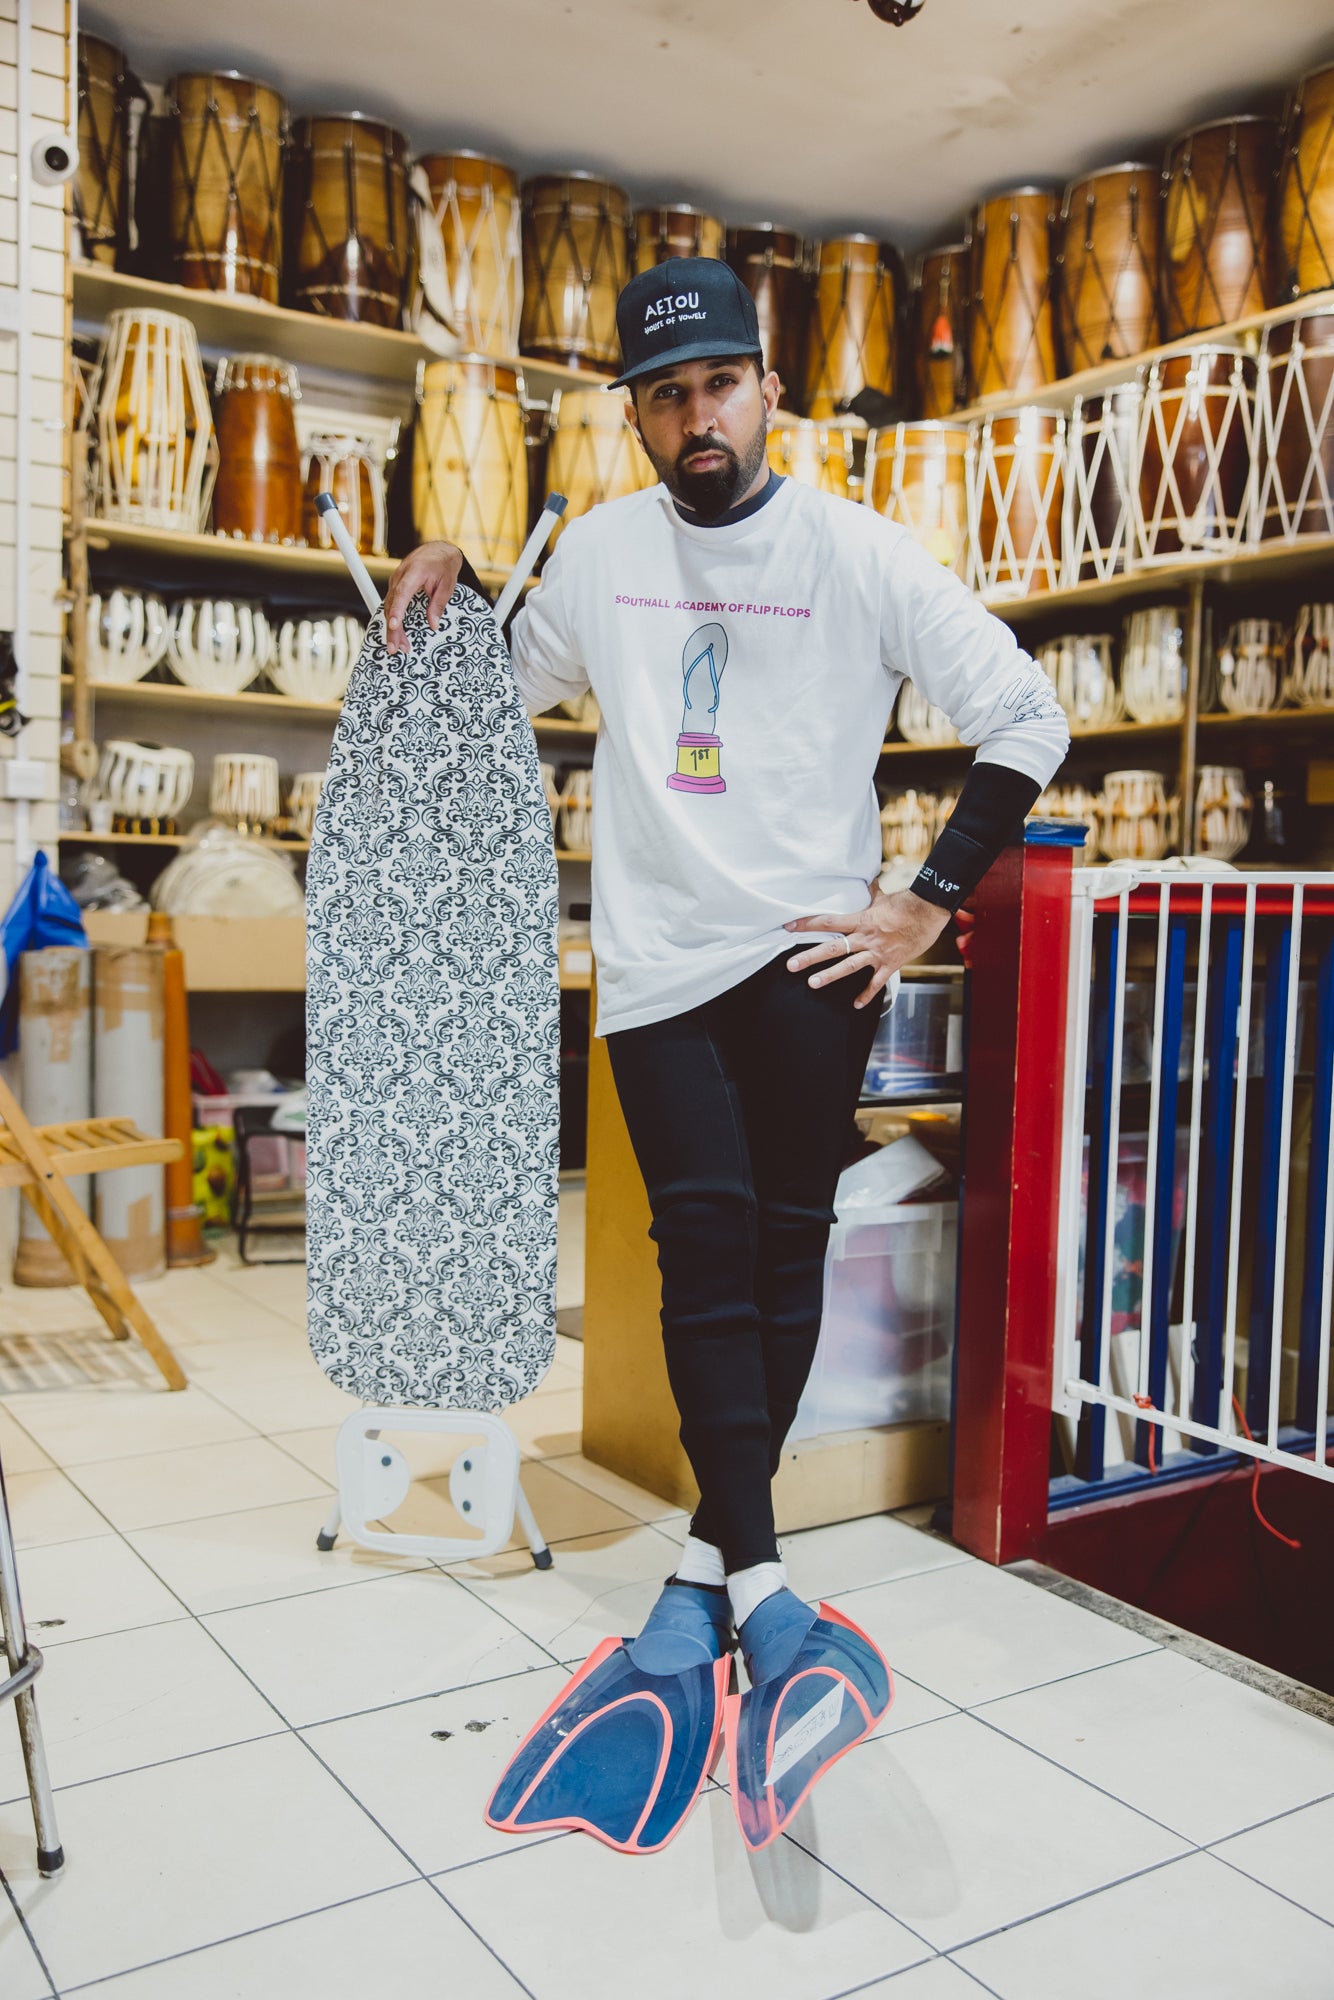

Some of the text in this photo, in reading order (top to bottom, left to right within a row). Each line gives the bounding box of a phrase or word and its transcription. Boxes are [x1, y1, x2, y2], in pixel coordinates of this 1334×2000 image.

[645, 292, 699, 321] AEIOU
[644, 311, 707, 335] HOUSE OF VOWELS
[615, 595, 811, 618] SOUTHALL ACADEMY OF FLIP FLOPS
[690, 748, 710, 771] 1ST
